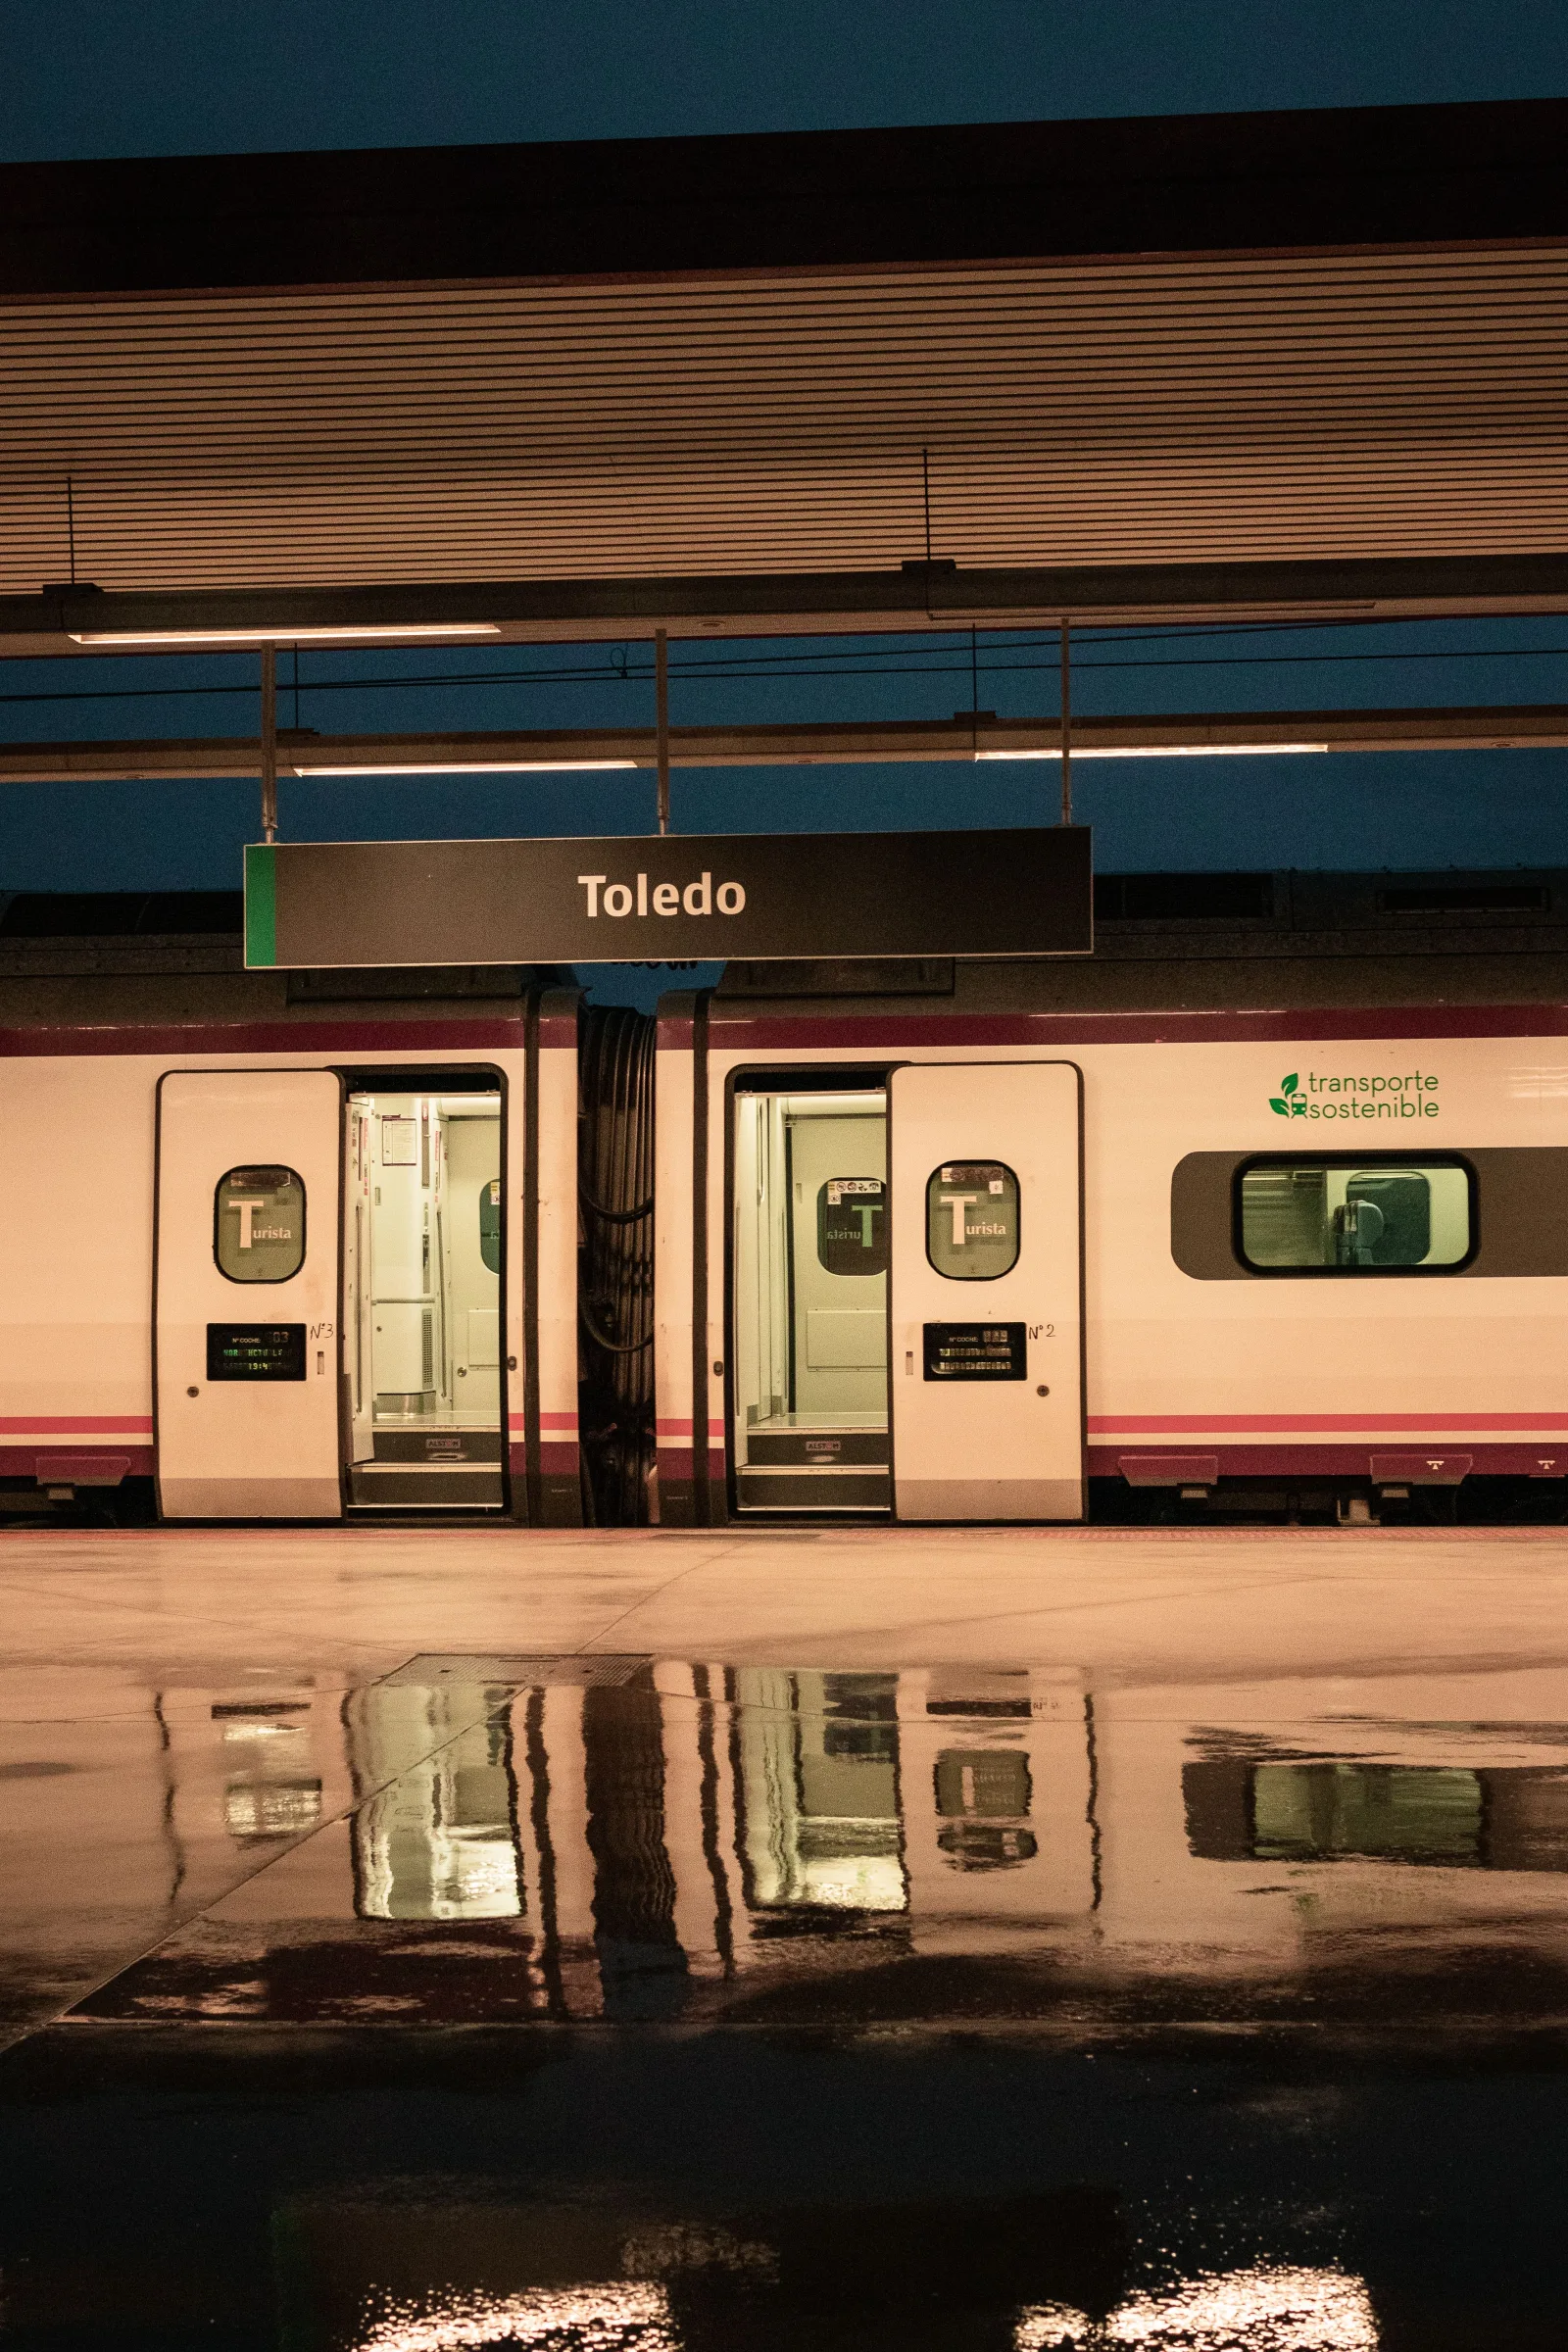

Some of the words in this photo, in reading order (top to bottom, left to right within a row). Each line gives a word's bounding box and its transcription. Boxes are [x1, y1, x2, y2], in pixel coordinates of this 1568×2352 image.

[577, 871, 747, 917] Toledo
[1308, 1070, 1439, 1098] transporte
[1309, 1093, 1440, 1118] sostenible
[228, 1200, 292, 1249] Turista
[940, 1196, 1006, 1245] Turista
